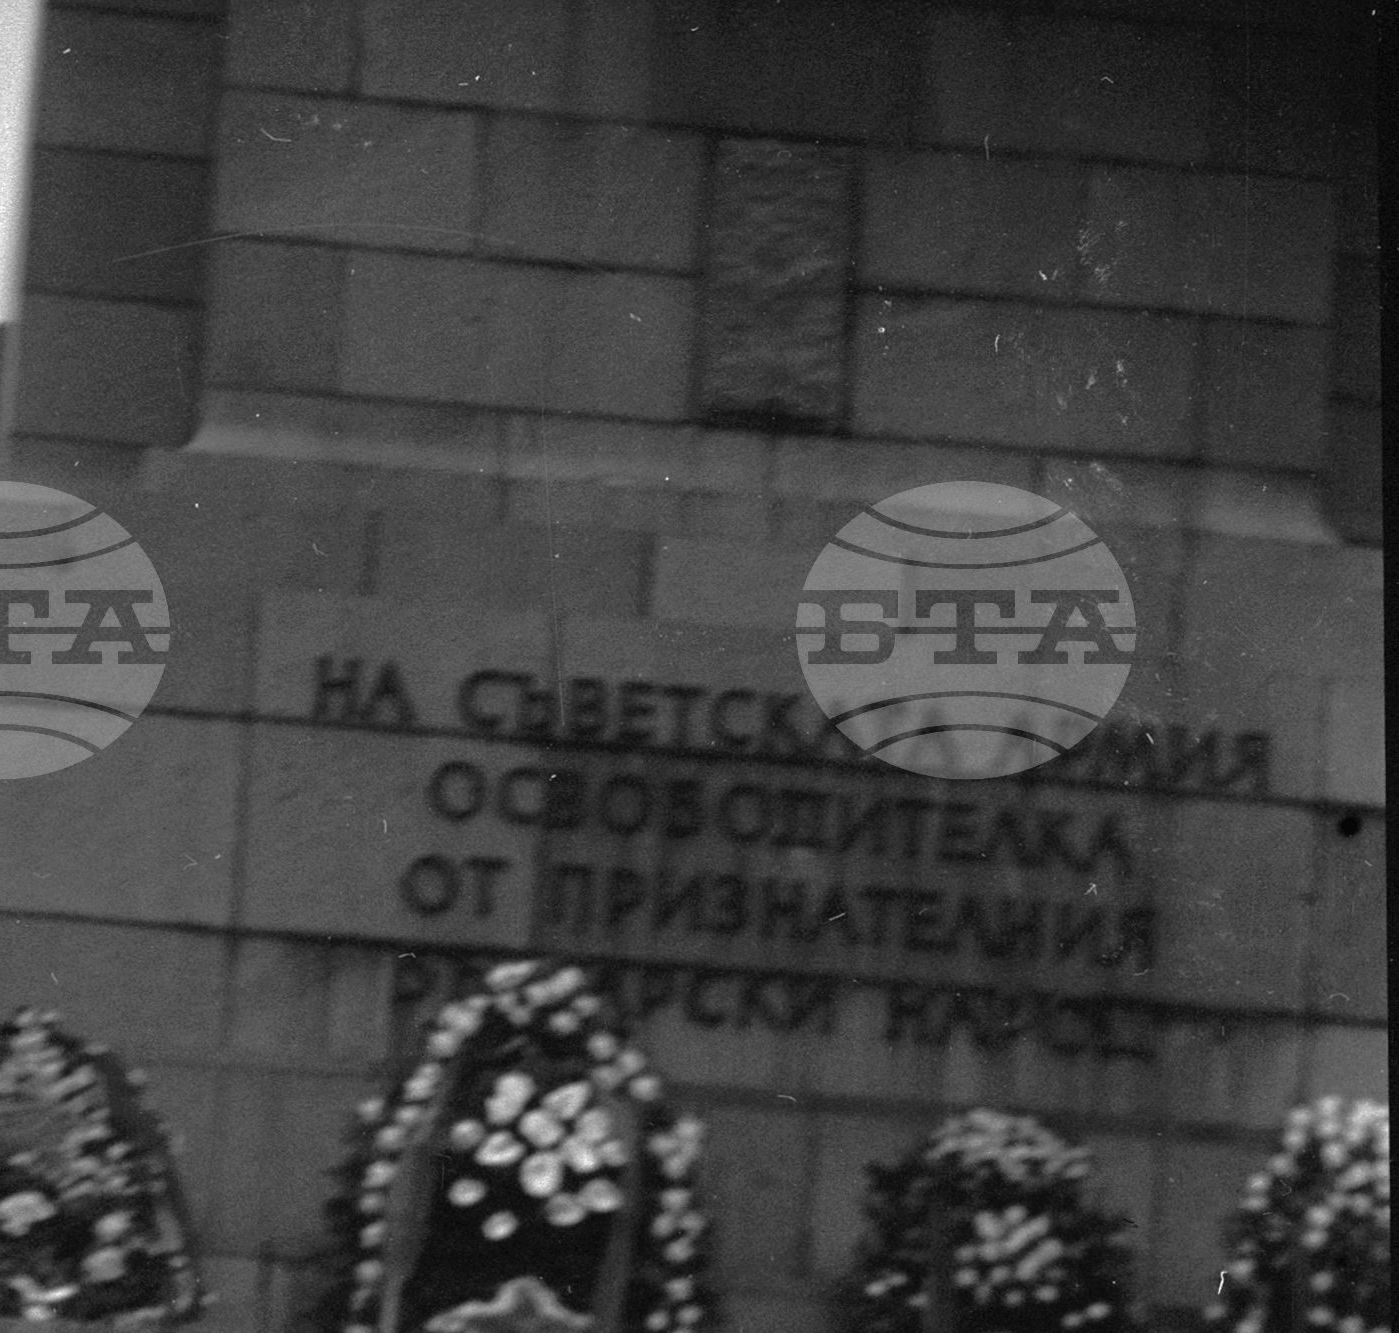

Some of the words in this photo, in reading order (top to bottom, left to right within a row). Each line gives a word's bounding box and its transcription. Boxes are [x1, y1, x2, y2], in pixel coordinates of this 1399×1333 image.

[310, 655, 416, 726] НА
[425, 758, 1134, 876] ОСВОБОДИТЕЛКА
[398, 853, 509, 918] ОТ
[544, 860, 1159, 970] ПРИЗНАТЕЛНИЯ
